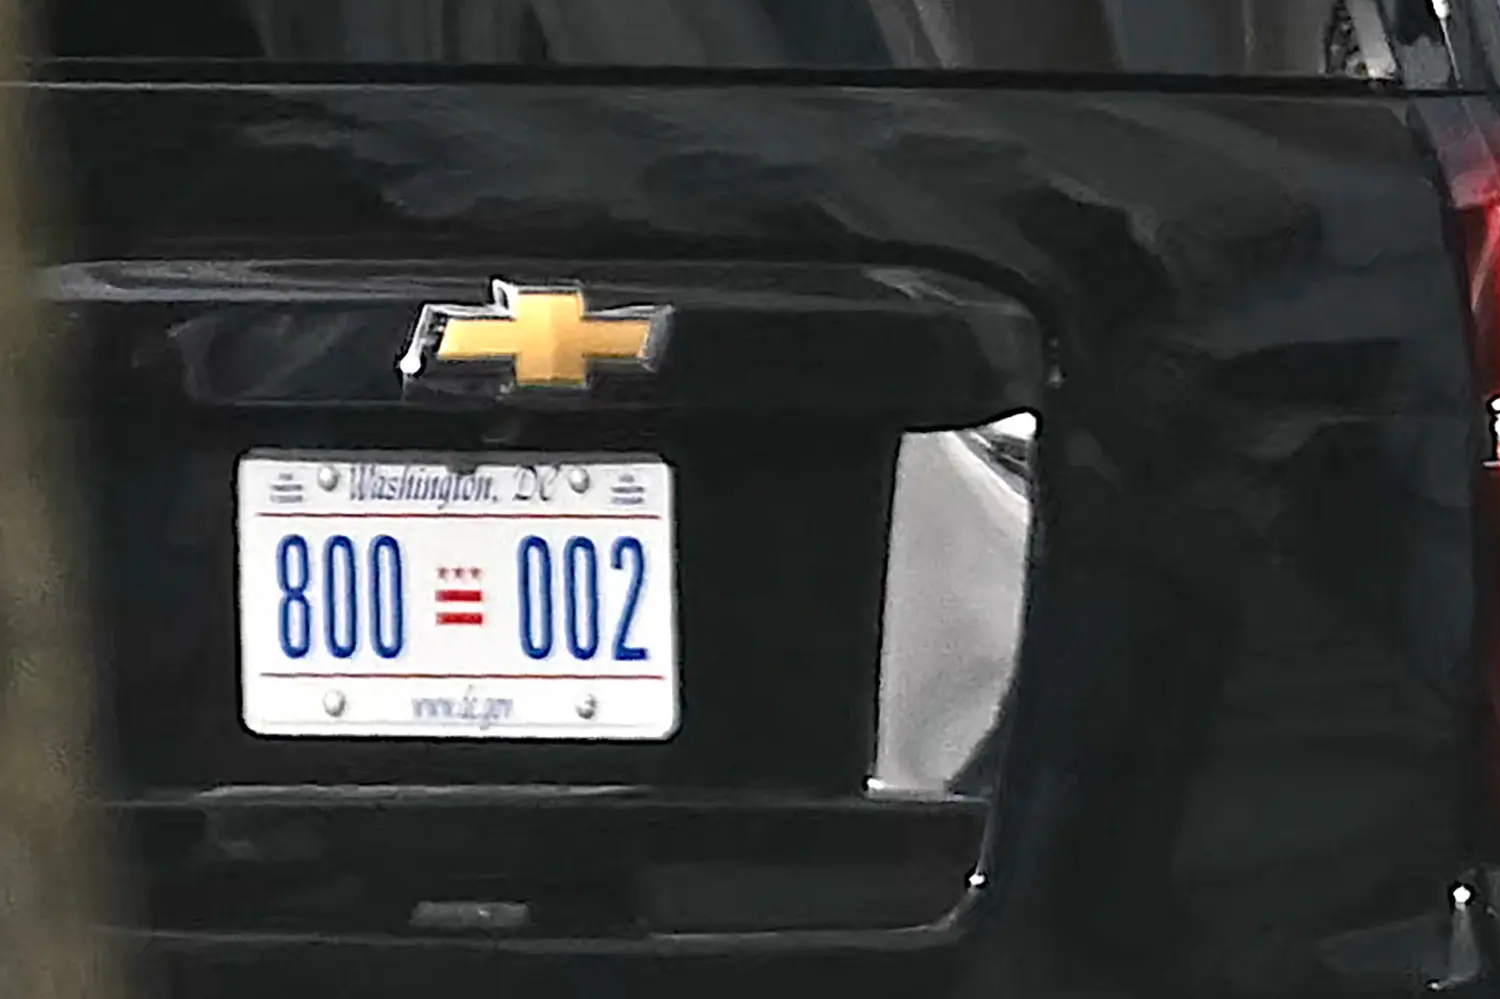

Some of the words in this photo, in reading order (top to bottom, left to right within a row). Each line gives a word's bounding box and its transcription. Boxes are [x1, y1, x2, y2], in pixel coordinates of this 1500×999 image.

[512, 465, 561, 502] DC
[275, 533, 405, 660] 800
[517, 535, 650, 661] 002
